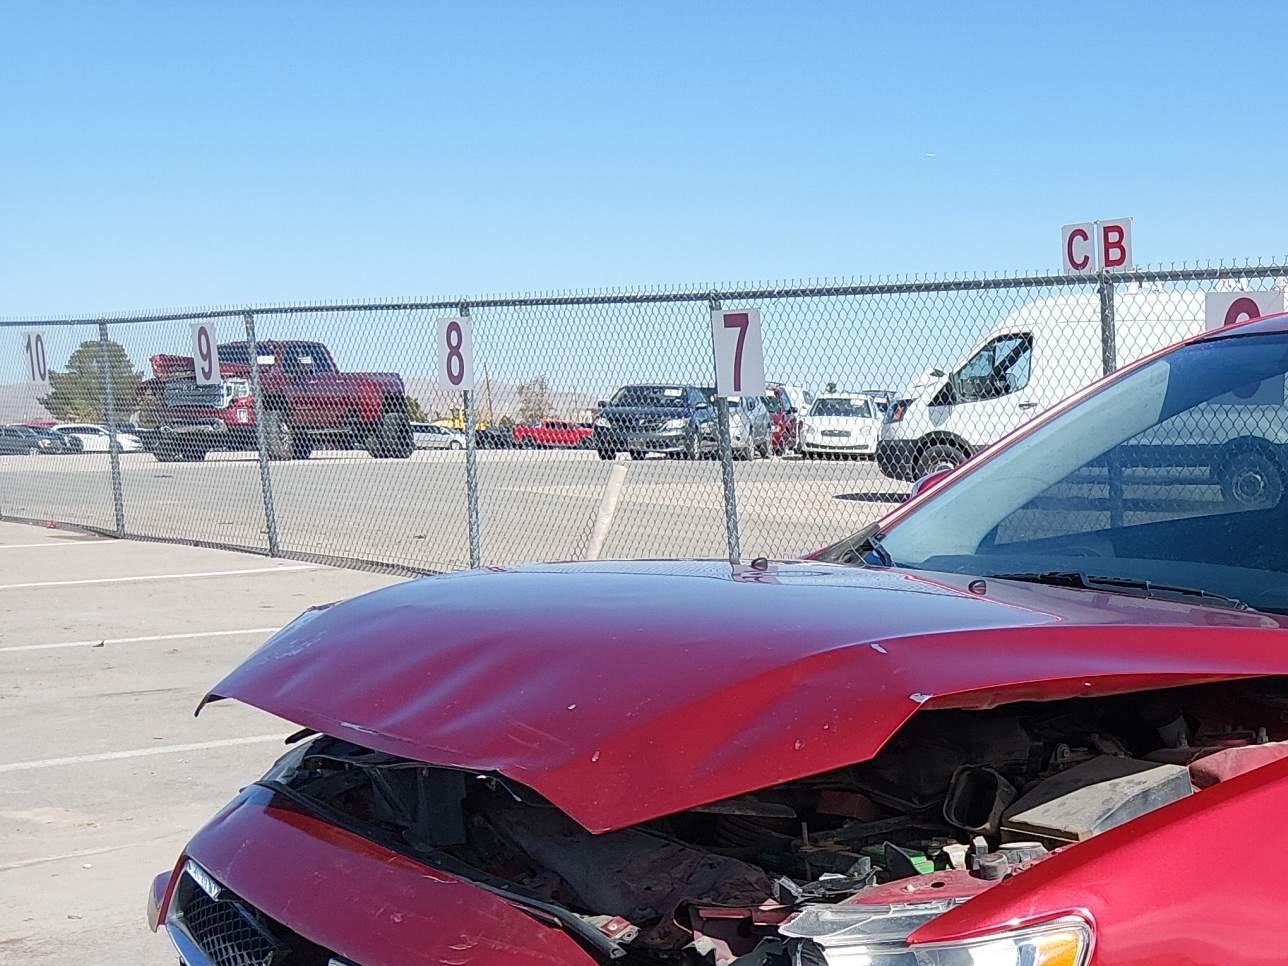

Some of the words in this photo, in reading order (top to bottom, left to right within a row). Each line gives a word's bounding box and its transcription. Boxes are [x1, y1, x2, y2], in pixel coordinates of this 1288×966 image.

[1066, 228, 1090, 271] C
[1102, 224, 1127, 268] B
[25, 333, 48, 382] 10
[196, 325, 213, 382] 9
[445, 320, 465, 386] 8
[722, 312, 750, 393] 7
